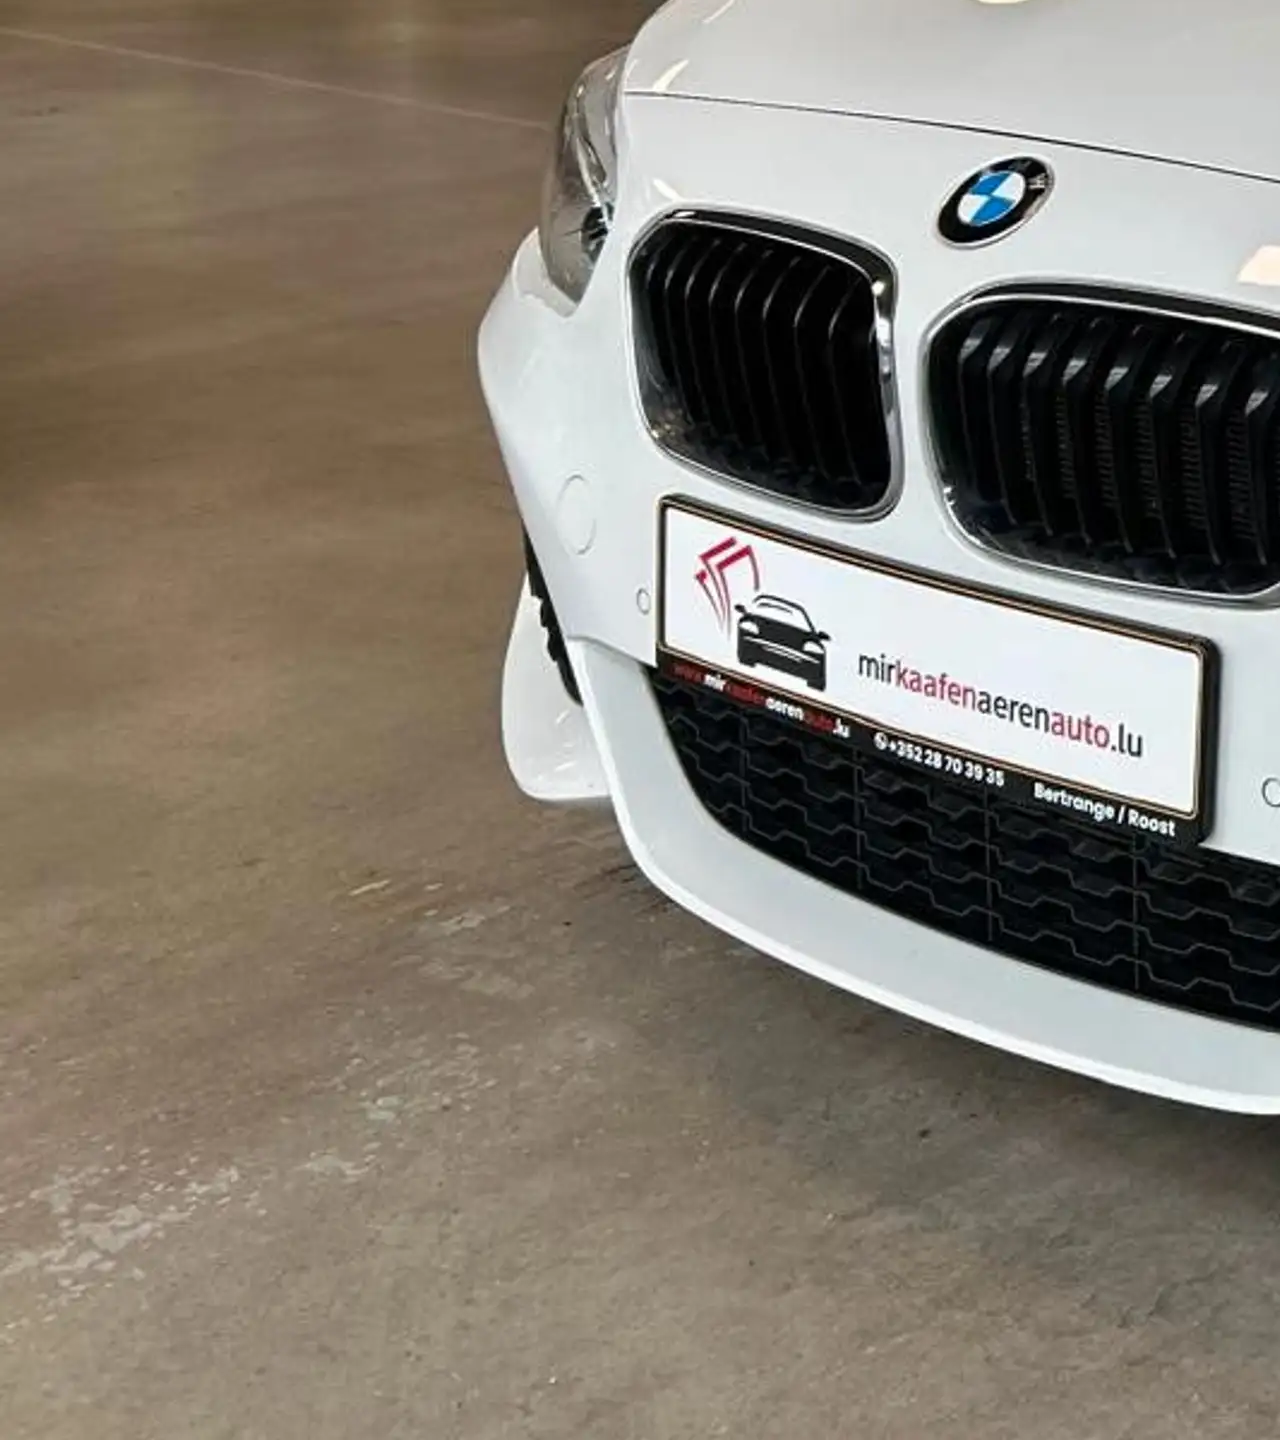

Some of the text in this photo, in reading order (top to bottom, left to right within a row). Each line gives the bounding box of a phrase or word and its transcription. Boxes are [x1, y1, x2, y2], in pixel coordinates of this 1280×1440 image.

[857, 652, 1144, 758] mirkaafenaerenauto.lu
[924, 749, 943, 770] 28
[945, 755, 963, 776] 70
[964, 760, 984, 781] 39
[1034, 782, 1114, 821] Bertrange
[1128, 809, 1177, 838] Roost
